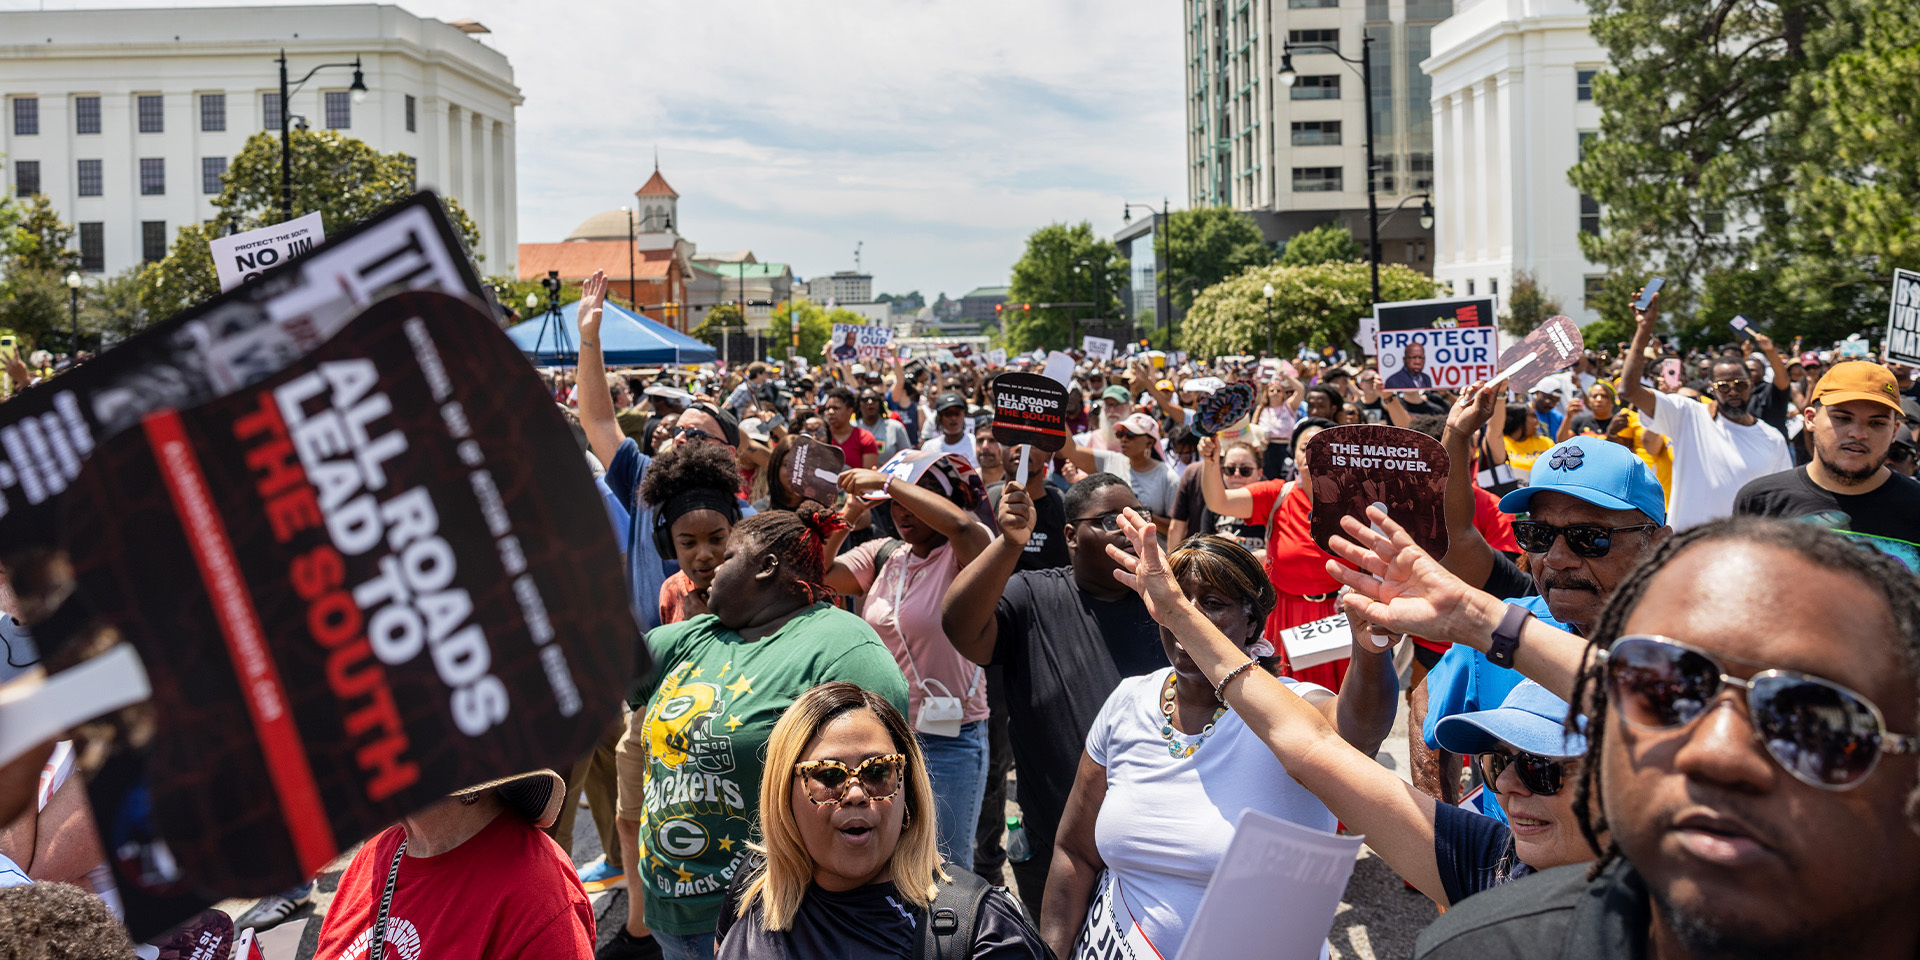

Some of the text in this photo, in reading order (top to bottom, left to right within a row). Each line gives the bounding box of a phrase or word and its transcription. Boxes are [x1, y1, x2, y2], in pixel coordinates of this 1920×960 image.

[235, 238, 273, 251] PROTECT
[276, 233, 290, 242] THE
[235, 236, 313, 272] NO JIM
[835, 324, 891, 336] PROTECT
[1381, 329, 1492, 348] PROTECT
[861, 336, 887, 345] OUR
[1435, 347, 1488, 363] OUR
[1430, 365, 1495, 386] VOTE!
[997, 392, 1059, 409] ALL ROADS
[997, 400, 1044, 414] LEAD TO
[997, 407, 1060, 424] THE SOUTH
[794, 446, 802, 470] MARCH
[1330, 443, 1419, 458] THE MARCH
[797, 478, 802, 486] IS
[801, 444, 809, 463] OVER.
[1332, 456, 1432, 472] IS NOT OVER.
[274, 370, 385, 556] LEAD
[352, 555, 424, 665] TO
[319, 358, 409, 491] ALL
[381, 485, 509, 736] ROADS
[232, 390, 323, 542] THE
[290, 545, 420, 800] SOUTH
[659, 820, 706, 856] G
[657, 874, 672, 894] GO
[674, 873, 720, 898] PACK
[200, 931, 213, 945] IS
[202, 936, 222, 960] THE
